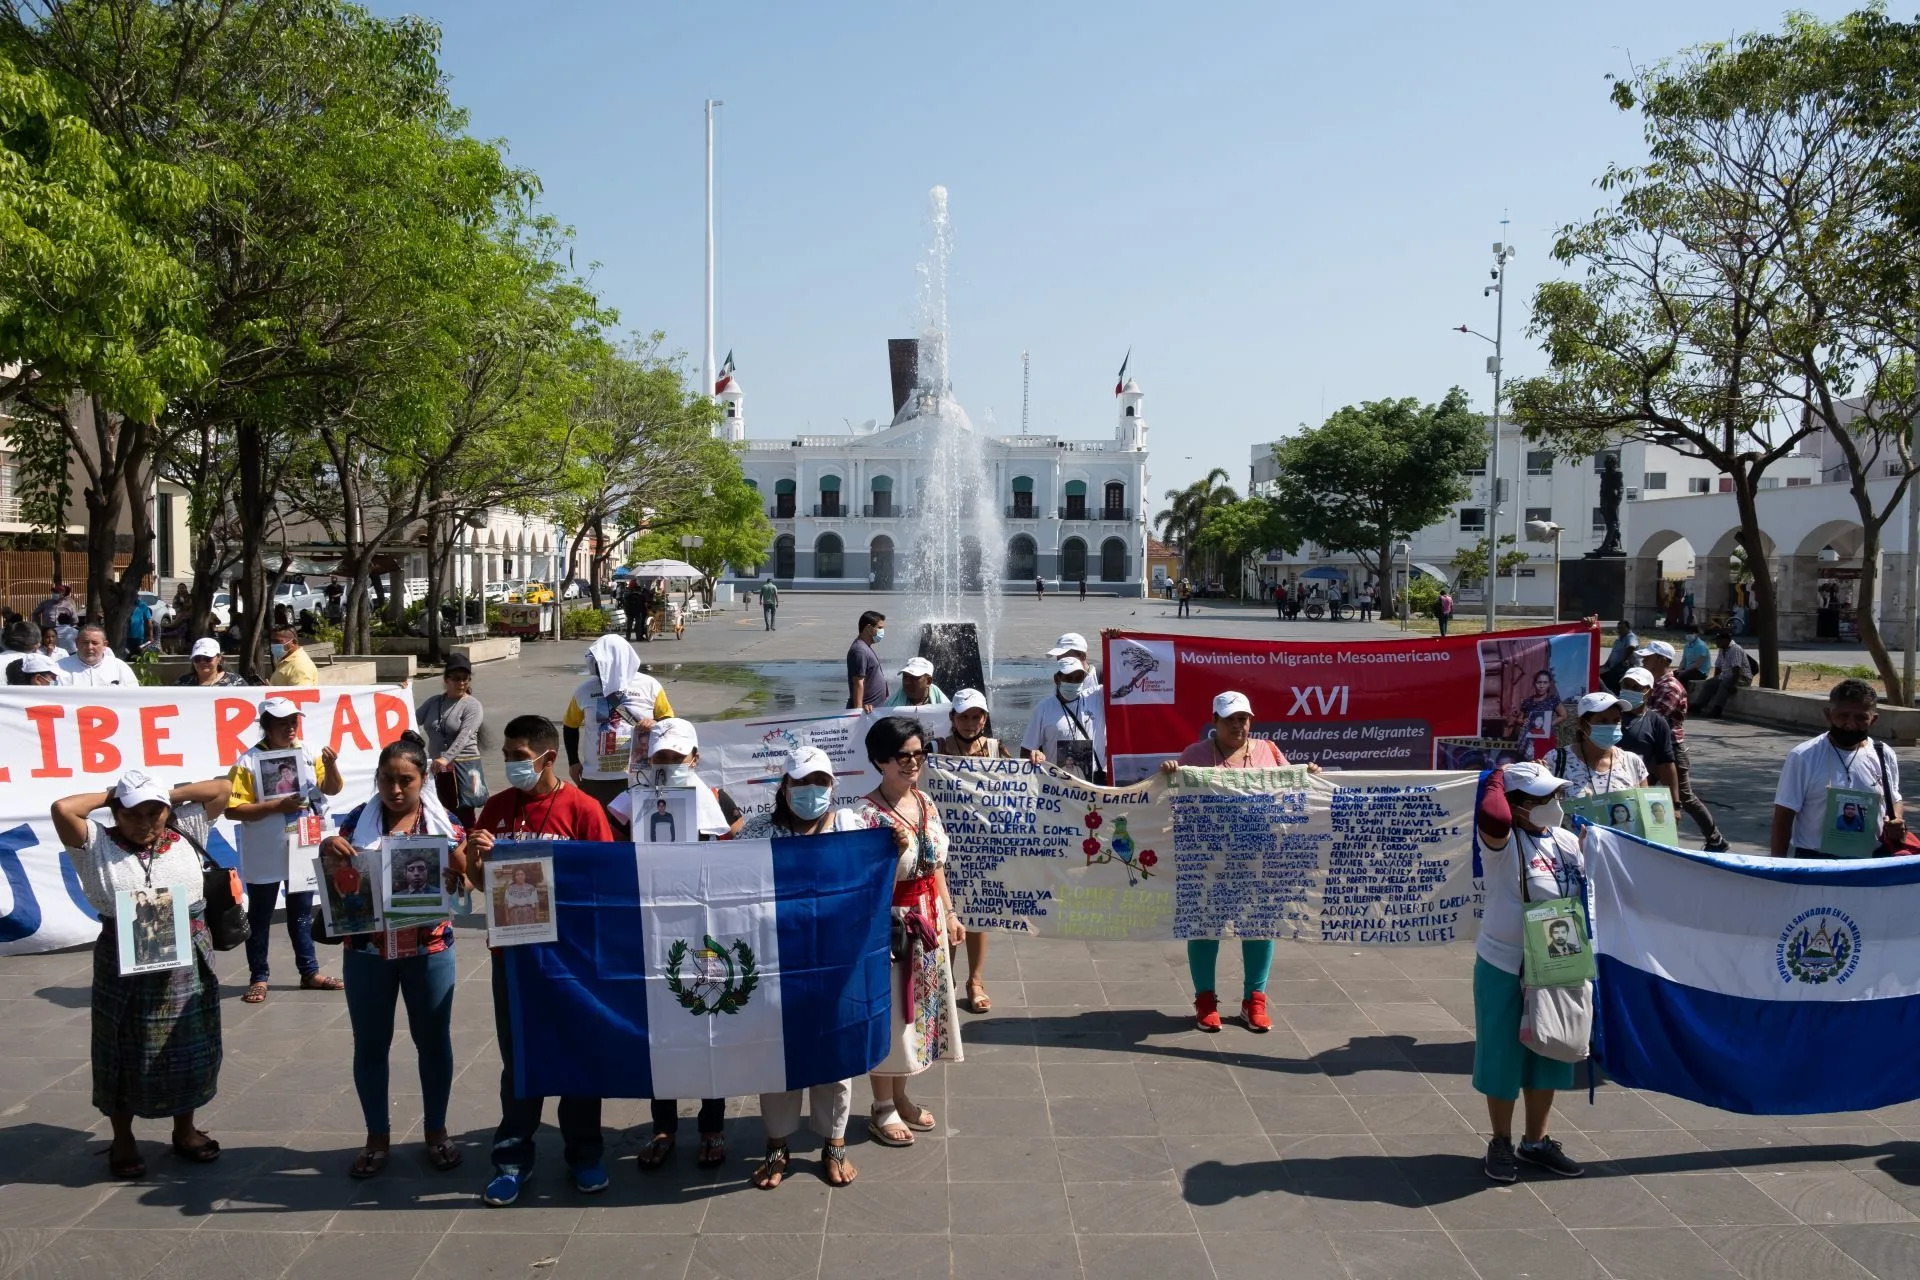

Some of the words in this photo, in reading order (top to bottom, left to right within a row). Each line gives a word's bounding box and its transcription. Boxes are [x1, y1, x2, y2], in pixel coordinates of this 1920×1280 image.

[1181, 651, 1266, 665] Movimiento
[1270, 652, 1333, 667] Migrante
[1337, 650, 1450, 664] Mesoamericano
[1286, 686, 1349, 716] XVI
[0, 689, 410, 784] IBERTAD
[1272, 728, 1288, 741] de
[1292, 728, 1339, 741] Madres
[1343, 727, 1358, 740] de
[1361, 726, 1425, 741] Migrantes
[1284, 751, 1310, 761] idos
[1312, 752, 1321, 763] y
[1322, 746, 1411, 762] Desaparecidas
[975, 780, 1028, 792] ALONZO
[988, 811, 1037, 824] OSORIO
[949, 854, 973, 862] TAVO
[1785, 923, 1796, 933] EL
[1792, 907, 1832, 926] SALVADOR
[389, 930, 397, 959] Guatem
